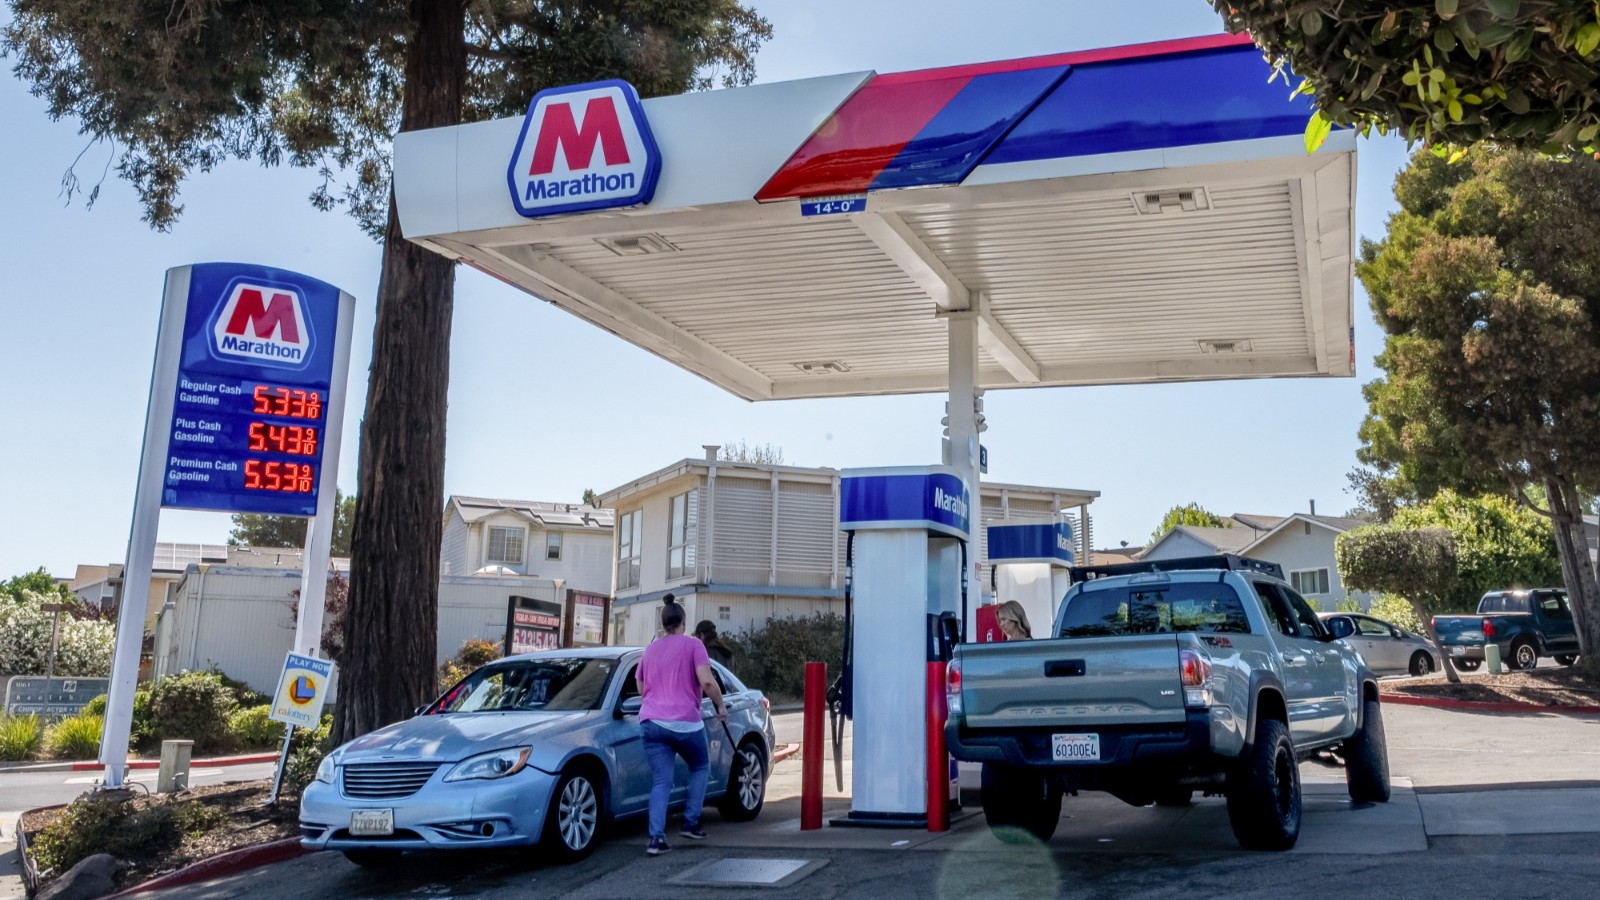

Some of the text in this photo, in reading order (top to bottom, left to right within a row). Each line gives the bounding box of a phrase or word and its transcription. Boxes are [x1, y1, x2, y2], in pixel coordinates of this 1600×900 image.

[528, 95, 631, 176] M
[525, 171, 635, 201] Marathon
[225, 288, 300, 344] M
[221, 335, 302, 360] Marathon
[181, 379, 242, 395] Regular Cash
[180, 392, 219, 406] Gasoline
[253, 385, 307, 418] 5.33
[175, 418, 221, 432] Plus Cash
[174, 430, 215, 444] Gasoline
[249, 422, 303, 454] 5.43
[170, 456, 238, 472] Premium Cash
[981, 450, 986, 465] 3
[169, 469, 210, 482] Gasoline
[245, 460, 299, 493] 5.53
[289, 656, 330, 672] PLAY NOW
[1009, 705, 1136, 716] TACOMA
[1055, 743, 1097, 757] 60300E4
